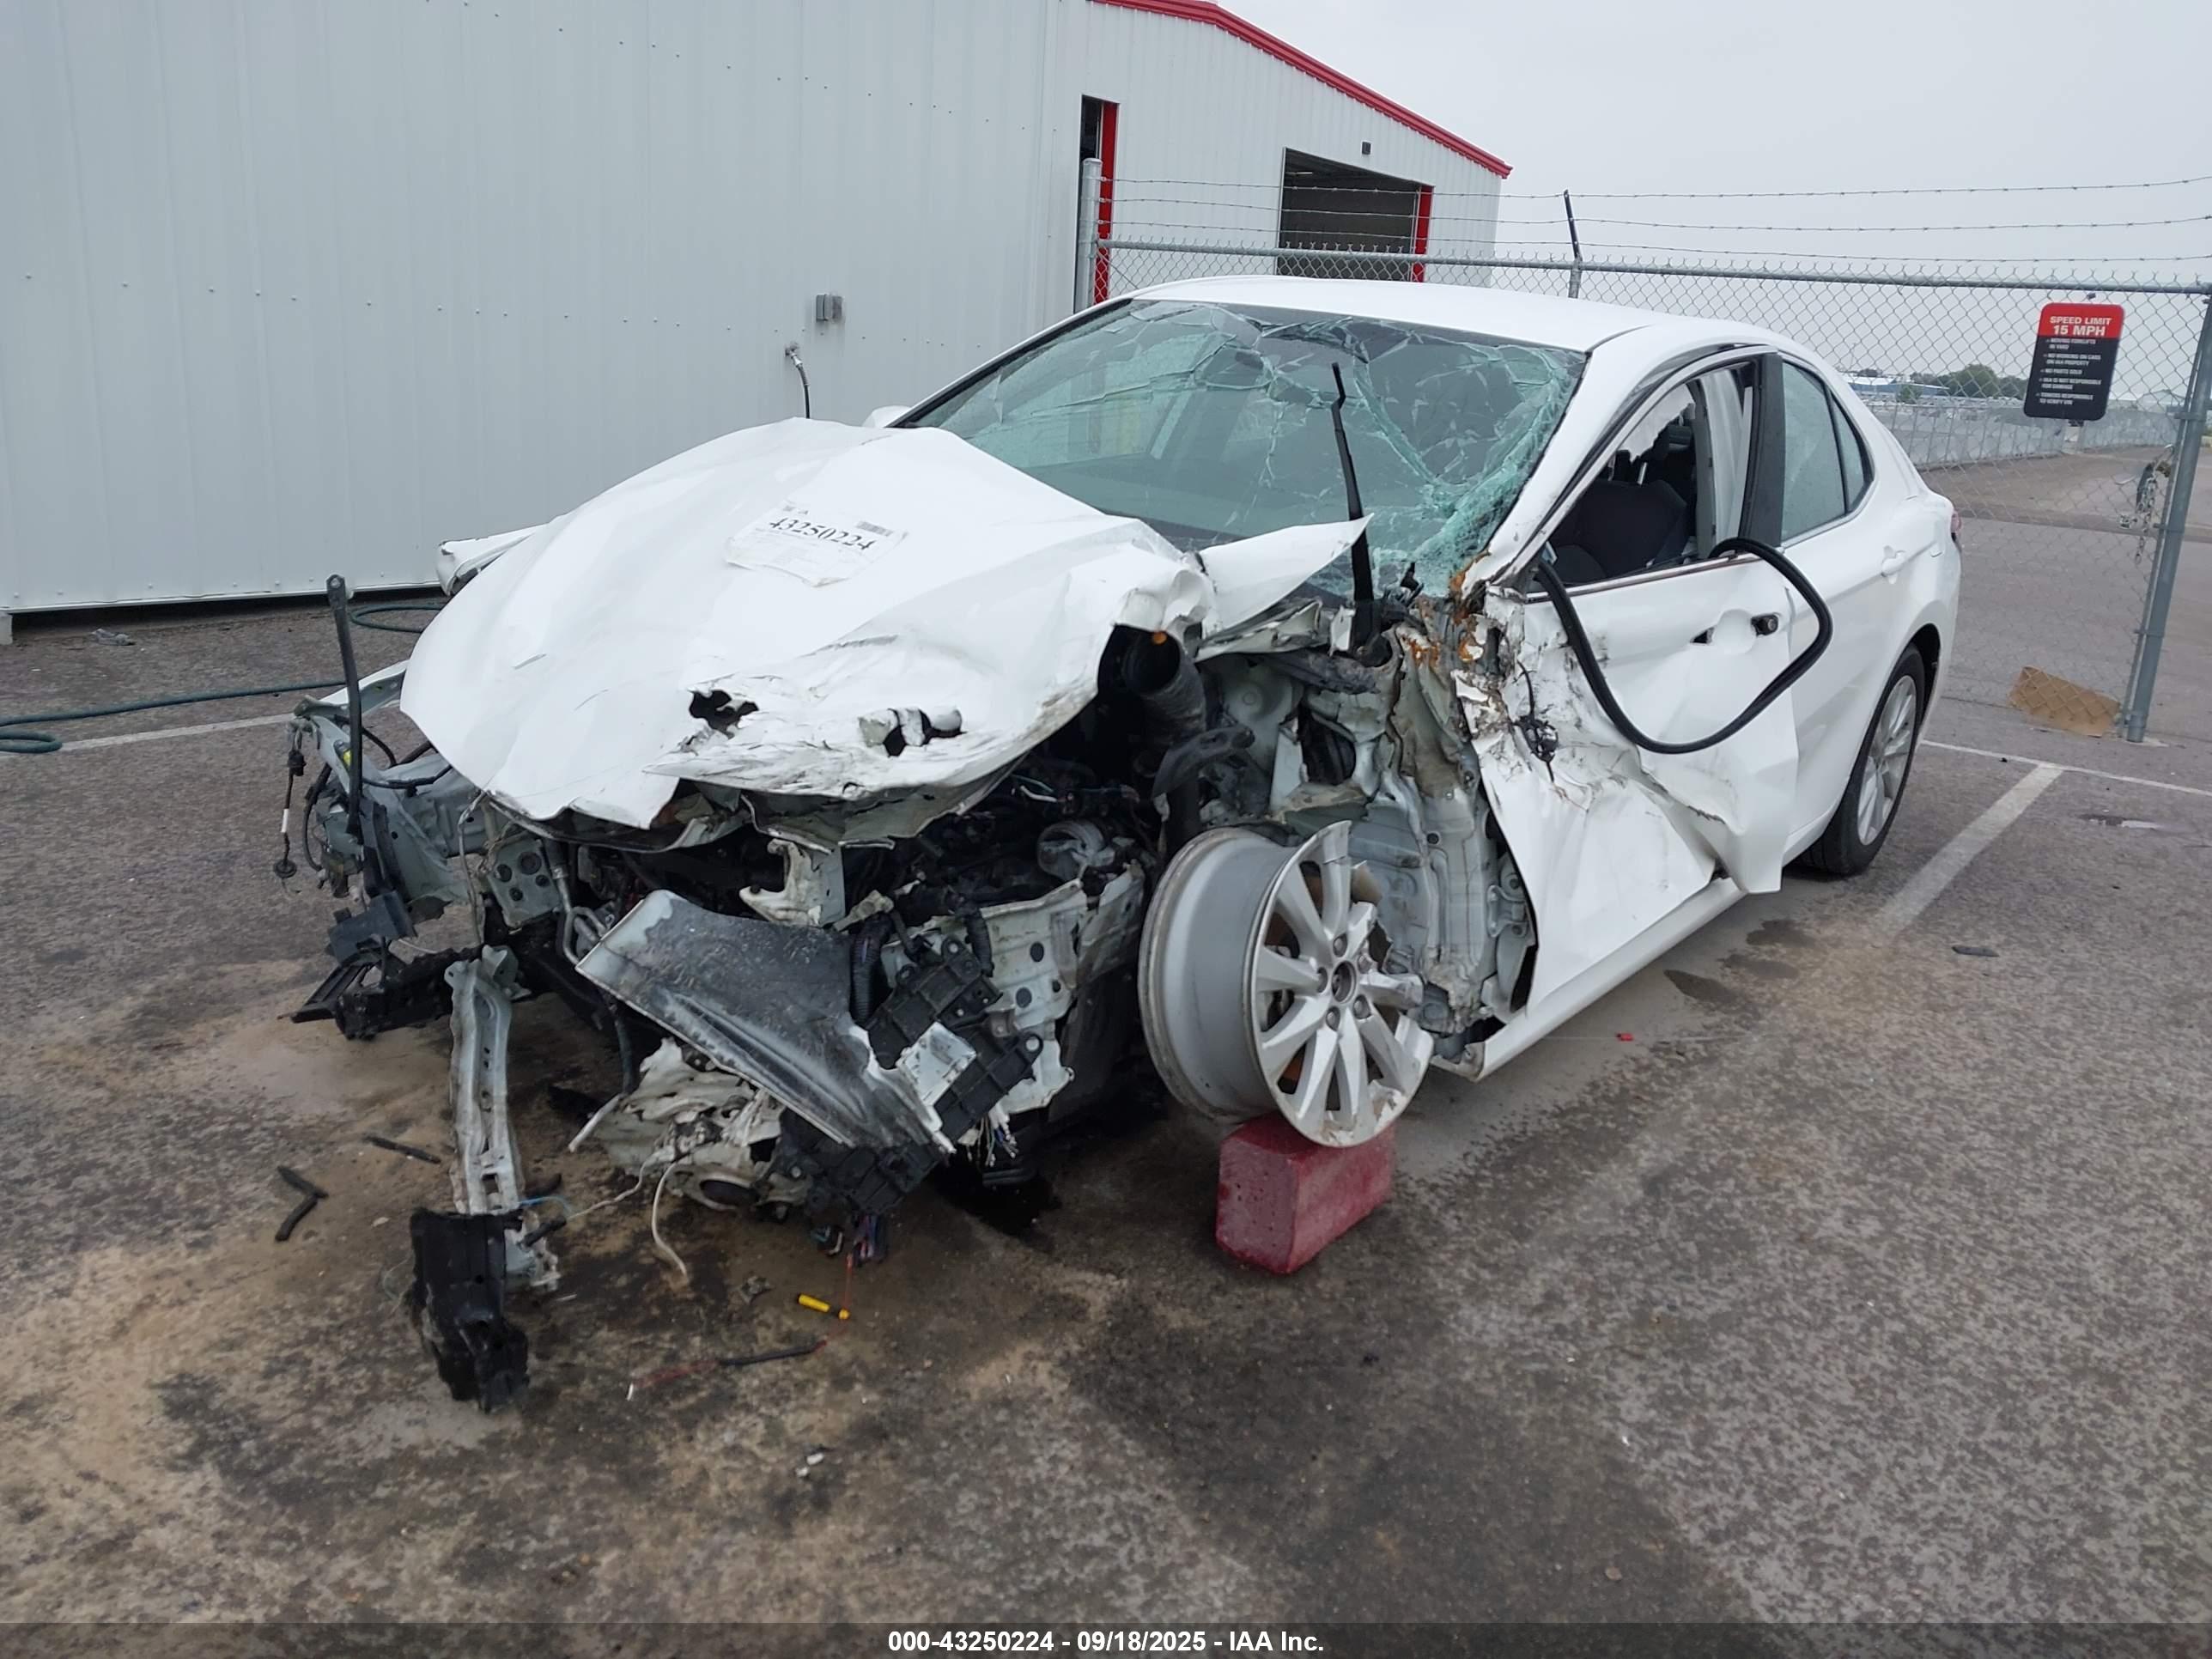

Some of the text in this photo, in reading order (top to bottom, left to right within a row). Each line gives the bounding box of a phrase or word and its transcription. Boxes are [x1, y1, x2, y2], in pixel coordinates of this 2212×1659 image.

[2050, 316, 2112, 325] SPEED LIMIT
[2054, 325, 2106, 336] 15 MPH
[769, 517, 876, 550] 43250224
